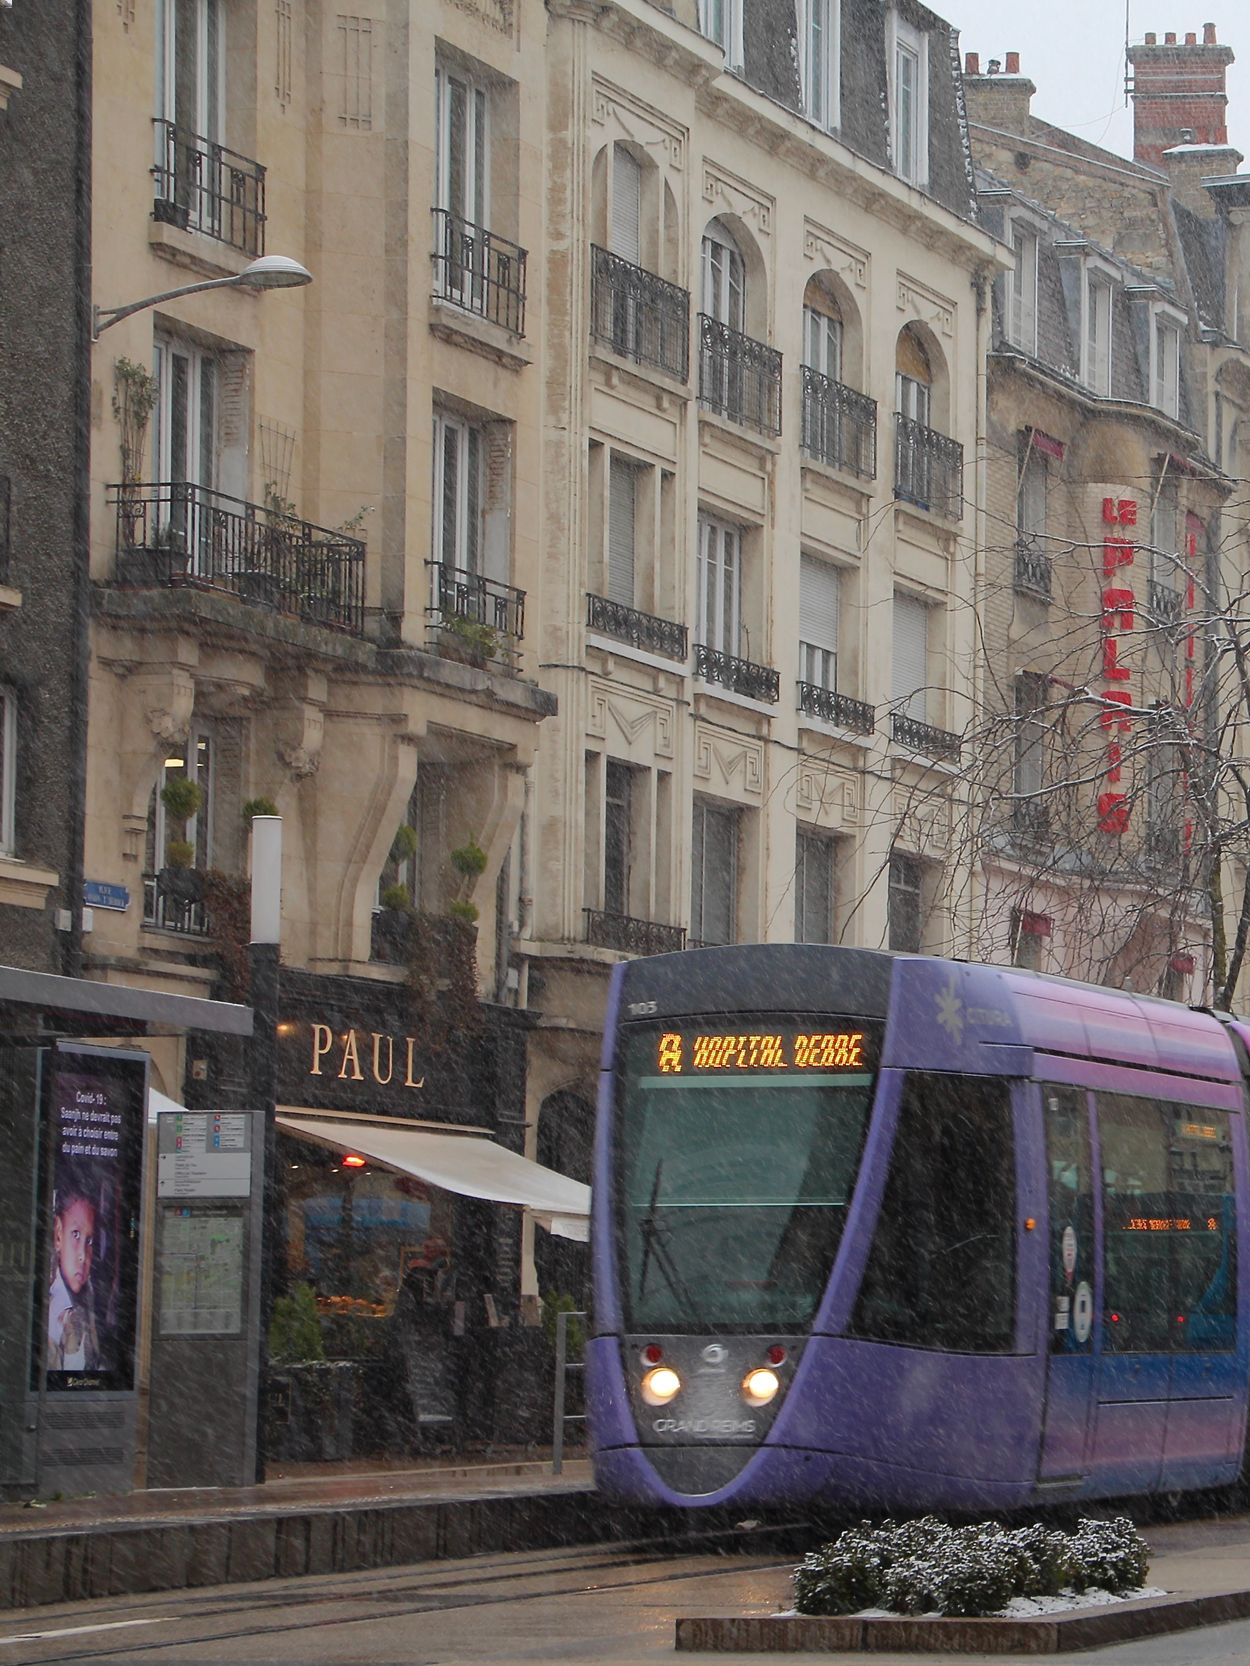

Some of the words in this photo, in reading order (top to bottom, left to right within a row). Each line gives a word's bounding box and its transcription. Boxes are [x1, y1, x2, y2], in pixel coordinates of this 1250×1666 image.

[1103, 498, 1137, 525] LE
[1097, 536, 1134, 834] PALAIS
[310, 1023, 425, 1088] PAUL
[659, 1033, 682, 1073] A
[694, 1036, 788, 1068] HOPITAL
[794, 1034, 864, 1067] DEBRE
[82, 1111, 89, 1121] ne
[90, 1110, 110, 1123] devrait
[62, 1125, 78, 1136] avoir
[83, 1126, 103, 1139] choisir
[103, 1130, 119, 1141] entre
[62, 1141, 71, 1153] du
[71, 1142, 85, 1157] pain
[84, 1144, 91, 1155] et
[92, 1144, 100, 1156] du
[100, 1146, 118, 1157] savon
